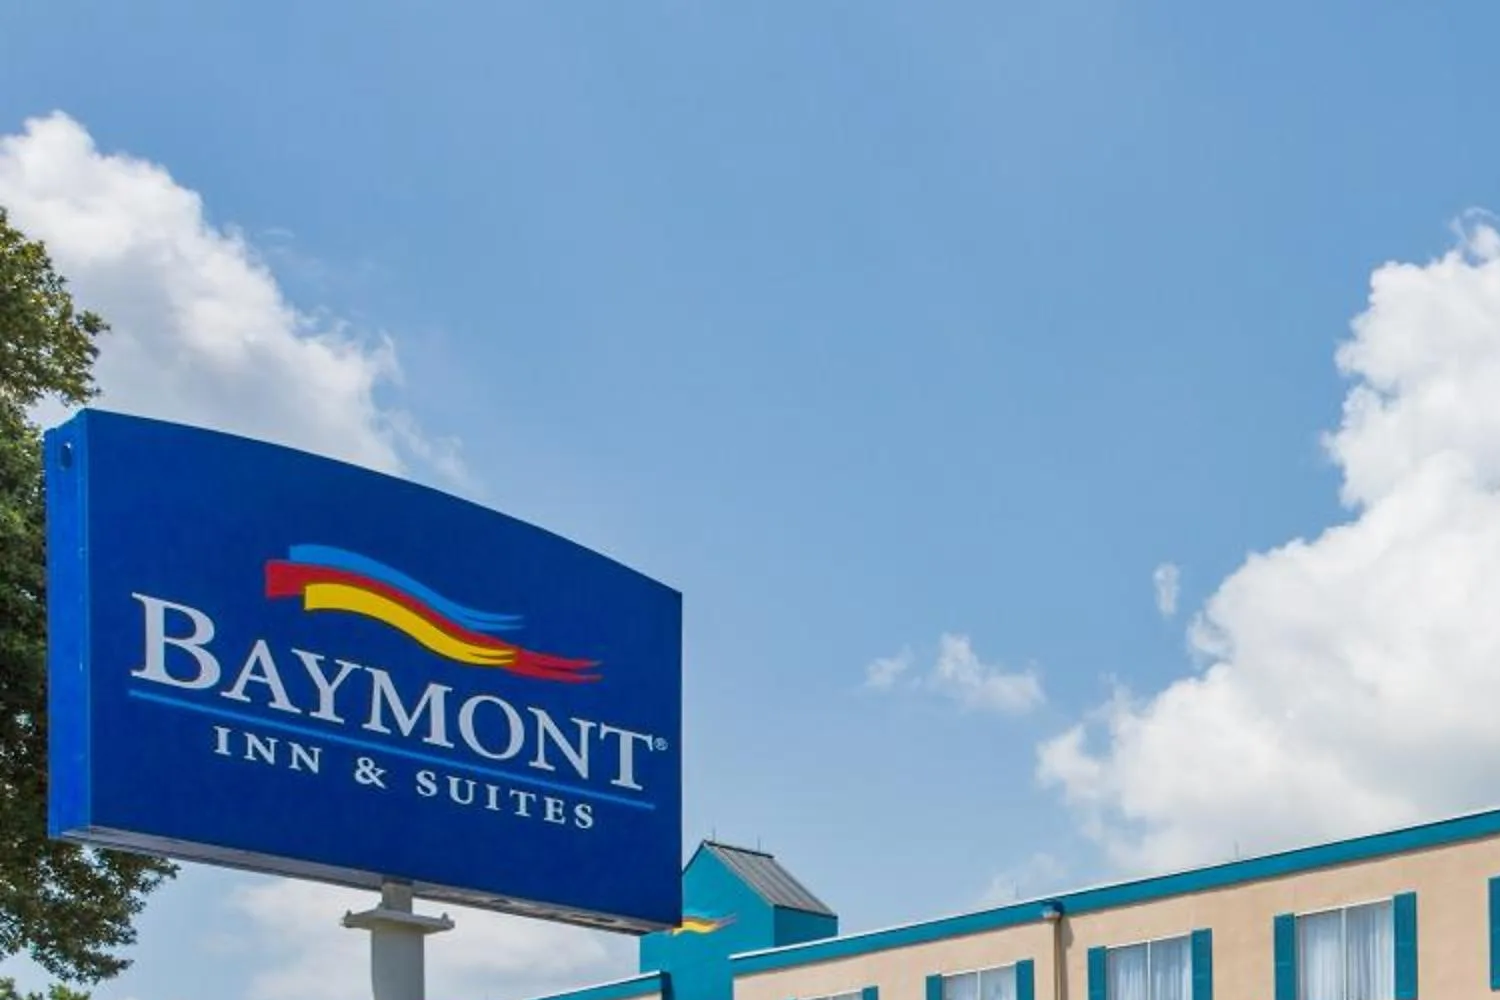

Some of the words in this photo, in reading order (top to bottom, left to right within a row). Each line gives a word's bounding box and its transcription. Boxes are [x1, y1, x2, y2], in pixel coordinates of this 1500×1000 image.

[213, 727, 322, 773] INN
[355, 758, 387, 788] &
[416, 770, 595, 828] SUITES
